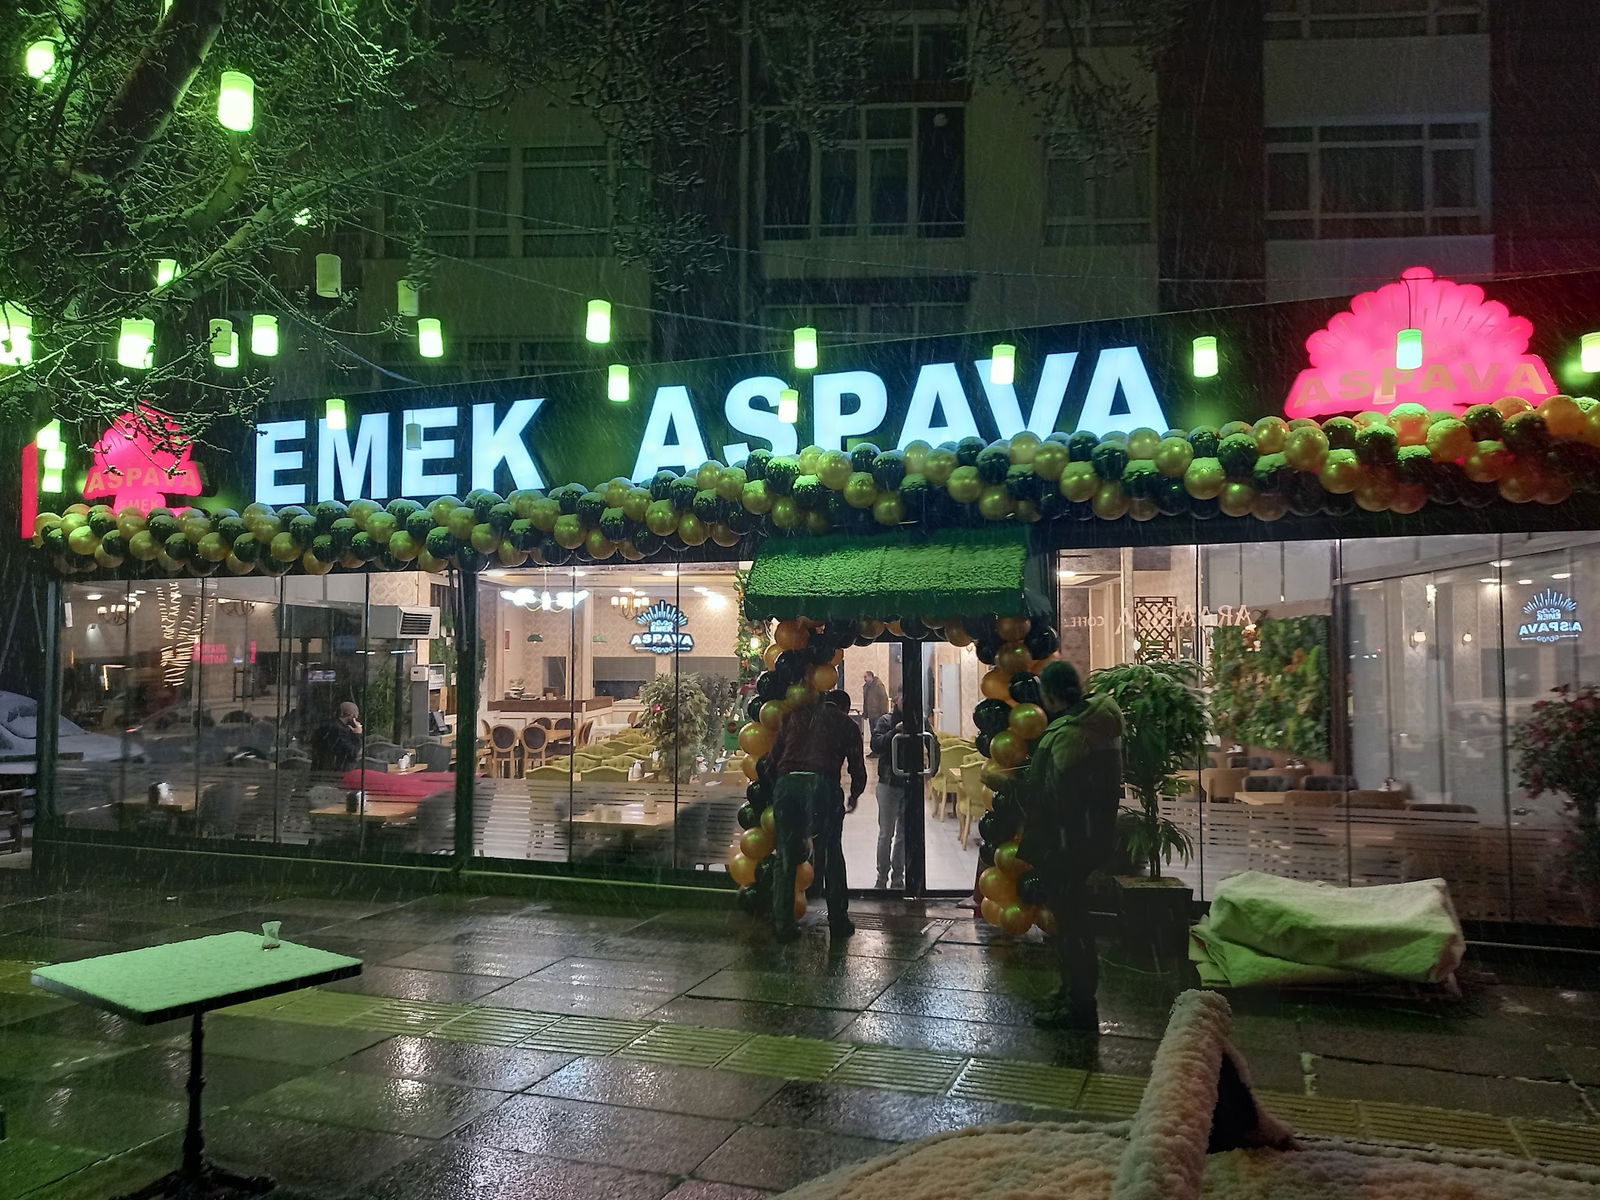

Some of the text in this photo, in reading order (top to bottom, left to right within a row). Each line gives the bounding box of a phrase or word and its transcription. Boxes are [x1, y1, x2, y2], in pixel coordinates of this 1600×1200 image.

[1294, 362, 1549, 408] ASPAVA
[256, 346, 1170, 505] EMEK ASPAVA
[88, 467, 197, 494] ASPAVA
[631, 634, 693, 645] ASPAVA
